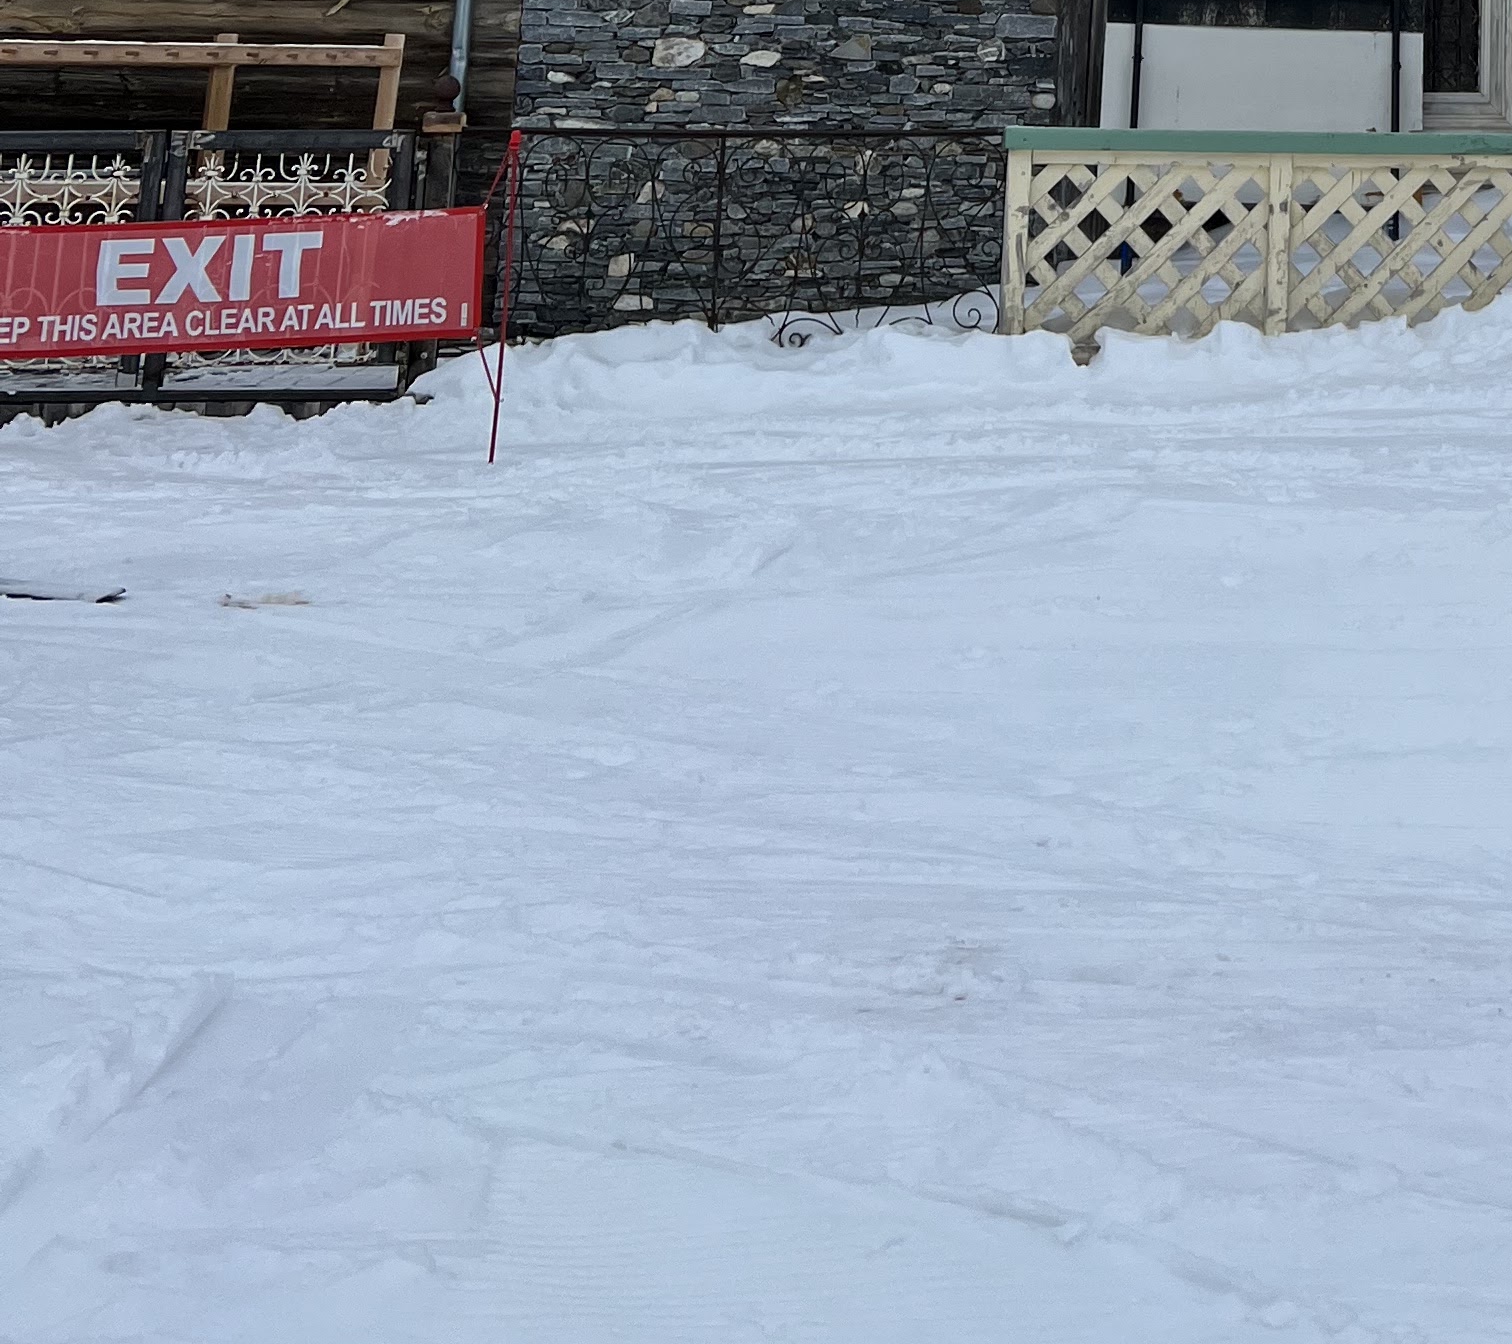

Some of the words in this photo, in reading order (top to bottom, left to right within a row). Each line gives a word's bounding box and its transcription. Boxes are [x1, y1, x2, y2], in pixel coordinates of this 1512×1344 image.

[96, 230, 324, 307] EXIT
[37, 314, 98, 342] THIS
[101, 311, 178, 340] AREA
[185, 307, 275, 337] CLEAR
[279, 303, 315, 332] AT
[314, 302, 366, 330] ALL
[369, 297, 447, 326] TIMES
